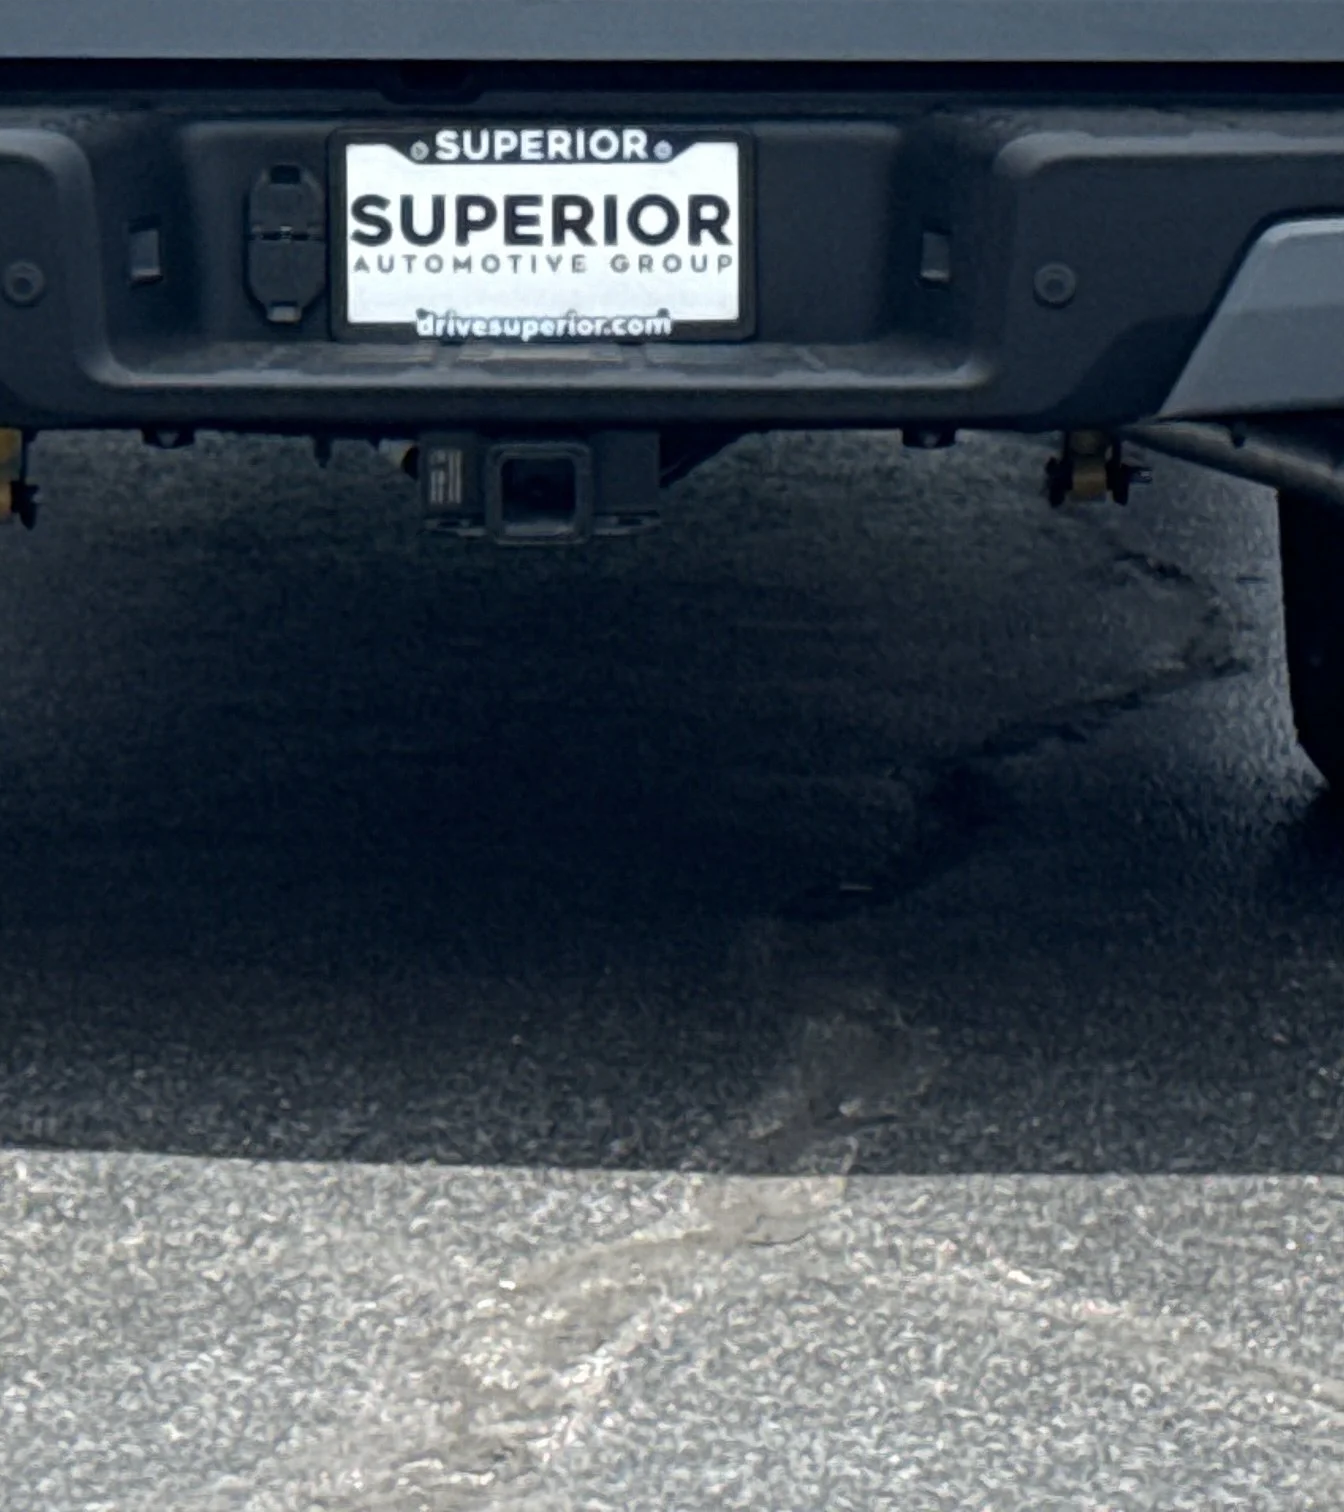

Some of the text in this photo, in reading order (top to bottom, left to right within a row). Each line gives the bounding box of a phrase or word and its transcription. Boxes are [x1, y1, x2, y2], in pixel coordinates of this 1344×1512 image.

[434, 128, 649, 161] SUPERIOR
[350, 193, 733, 248] SUPERIOR
[353, 253, 733, 274] AUTOMOTIVE GROUP
[416, 313, 673, 342] drivesuperior.com
